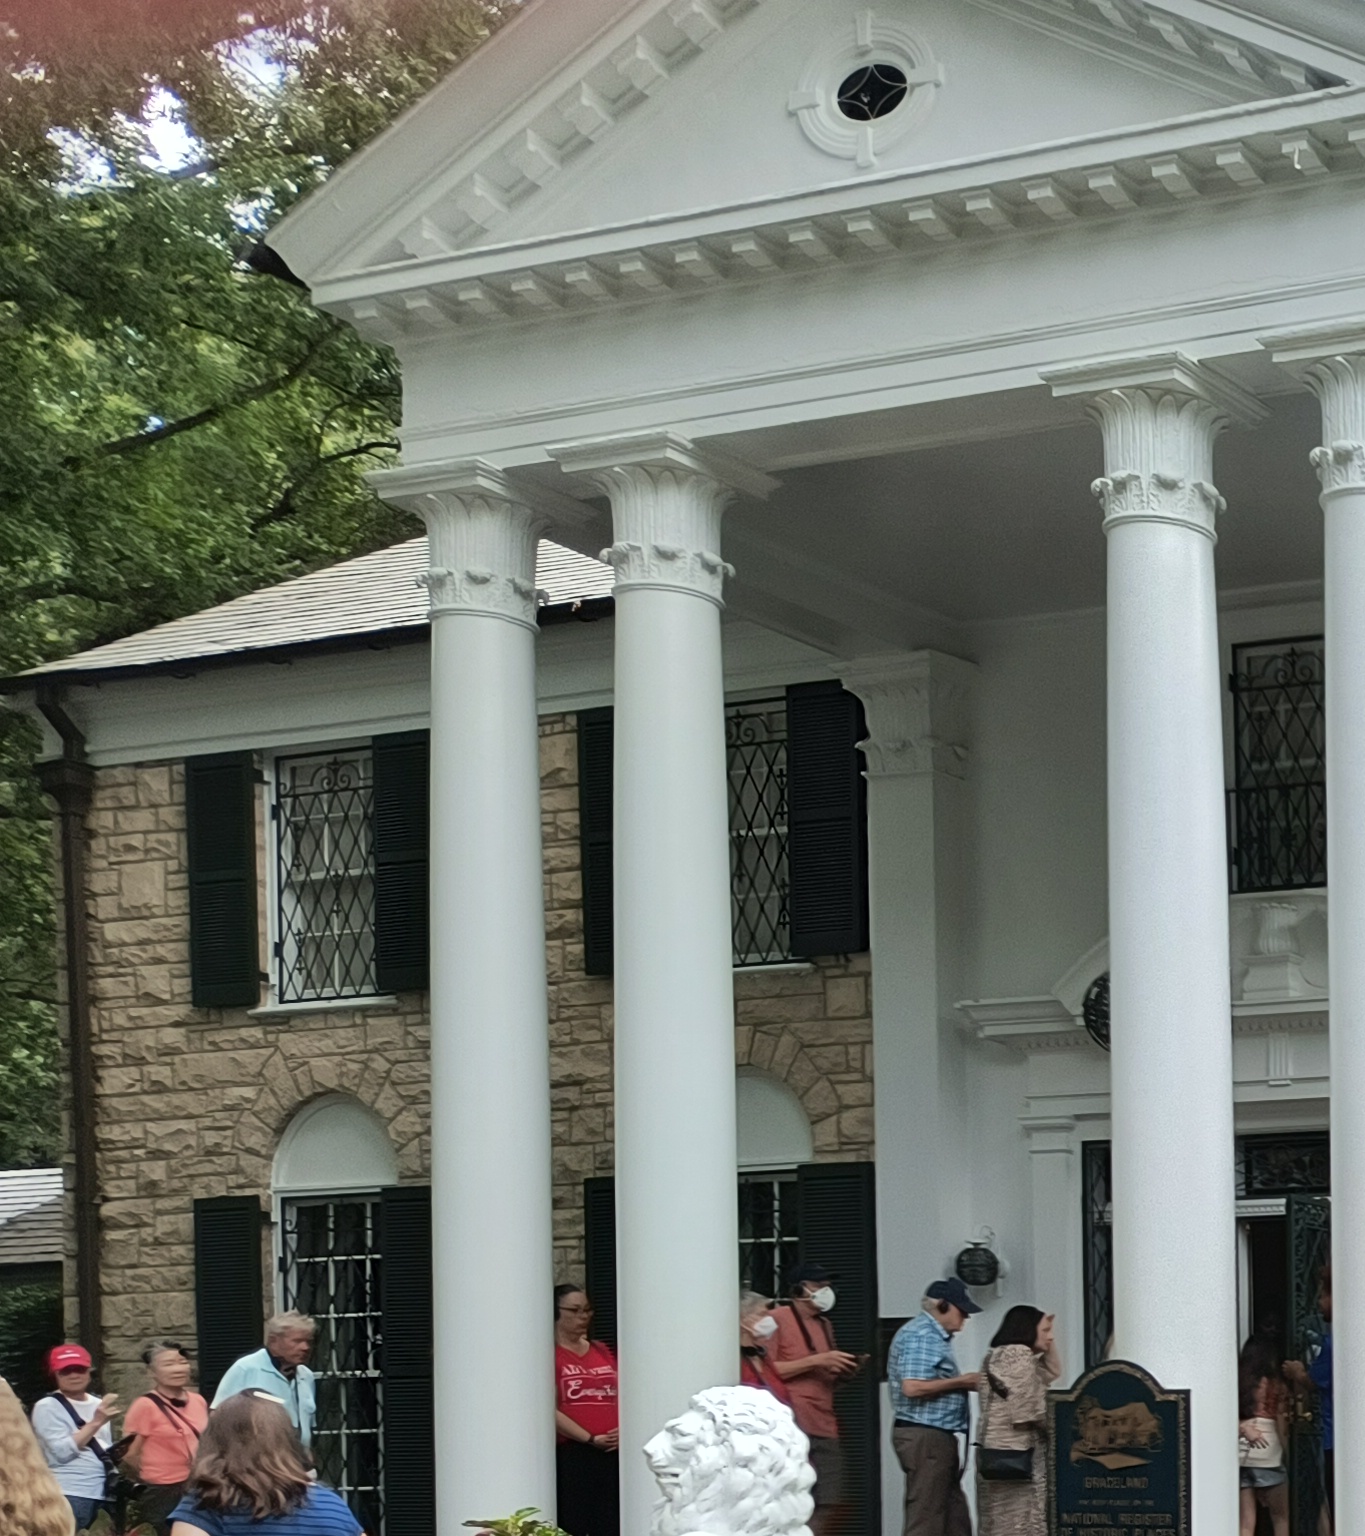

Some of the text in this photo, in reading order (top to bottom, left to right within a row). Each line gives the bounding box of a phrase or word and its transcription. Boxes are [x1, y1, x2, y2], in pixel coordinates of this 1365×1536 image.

[1084, 1476, 1149, 1489] GRACELAND
[1061, 1512, 1173, 1525] NATIONAL REGISTER
